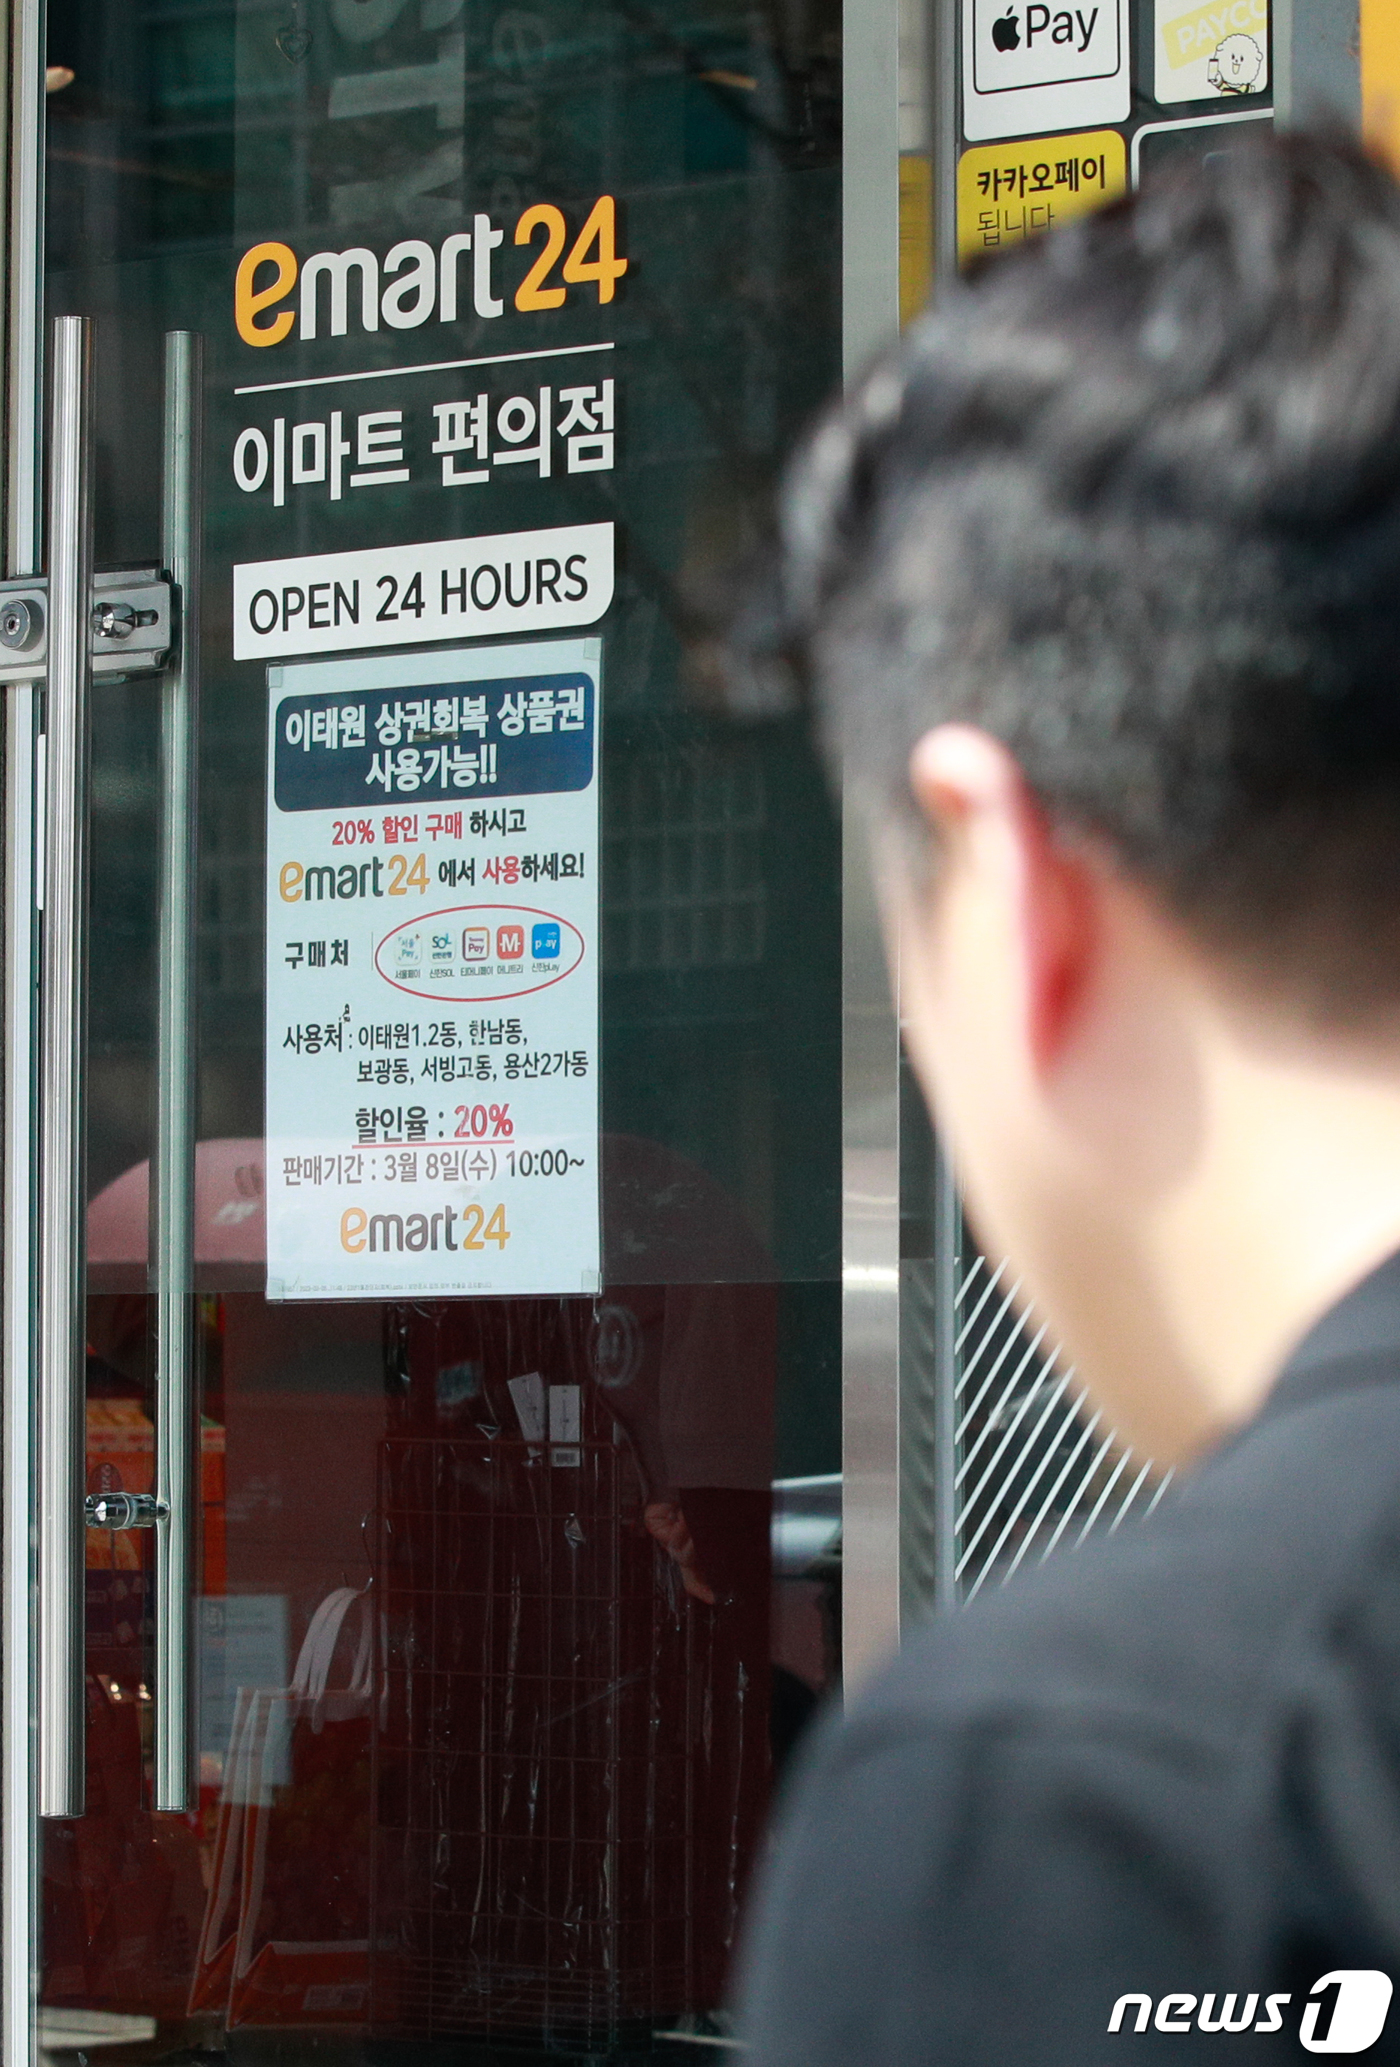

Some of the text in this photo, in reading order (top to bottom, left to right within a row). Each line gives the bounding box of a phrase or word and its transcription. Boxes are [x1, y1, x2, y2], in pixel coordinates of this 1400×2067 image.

[1025, 3, 1098, 53] Pay
[977, 155, 1105, 201] 카카오페이
[235, 195, 628, 347] emart24
[233, 379, 614, 507] 이마트 편의점
[249, 555, 588, 635] OPEN 24 HOURS
[285, 687, 585, 752] 이태원 상권회복 상품권
[365, 743, 497, 792] 사용가능!!
[332, 808, 527, 845] 20% 할인 구매 하시고
[280, 852, 585, 902] emart24 에서 사용하세요!
[285, 939, 349, 969] 구매처
[282, 1022, 342, 1054] 사용처
[358, 1021, 462, 1050] 이태원1.2동,
[469, 1018, 528, 1046] 한남동,
[357, 1050, 588, 1085] 보광동, 서빙고동, 용산2가동
[355, 1105, 428, 1144] 할인율
[454, 1103, 513, 1138] 20%
[282, 1153, 363, 1186] 판매기간
[384, 1151, 418, 1183] 3월
[425, 1149, 497, 1181] 8일(수)
[506, 1148, 585, 1178] 10:00~
[340, 1203, 510, 1254] emart24
